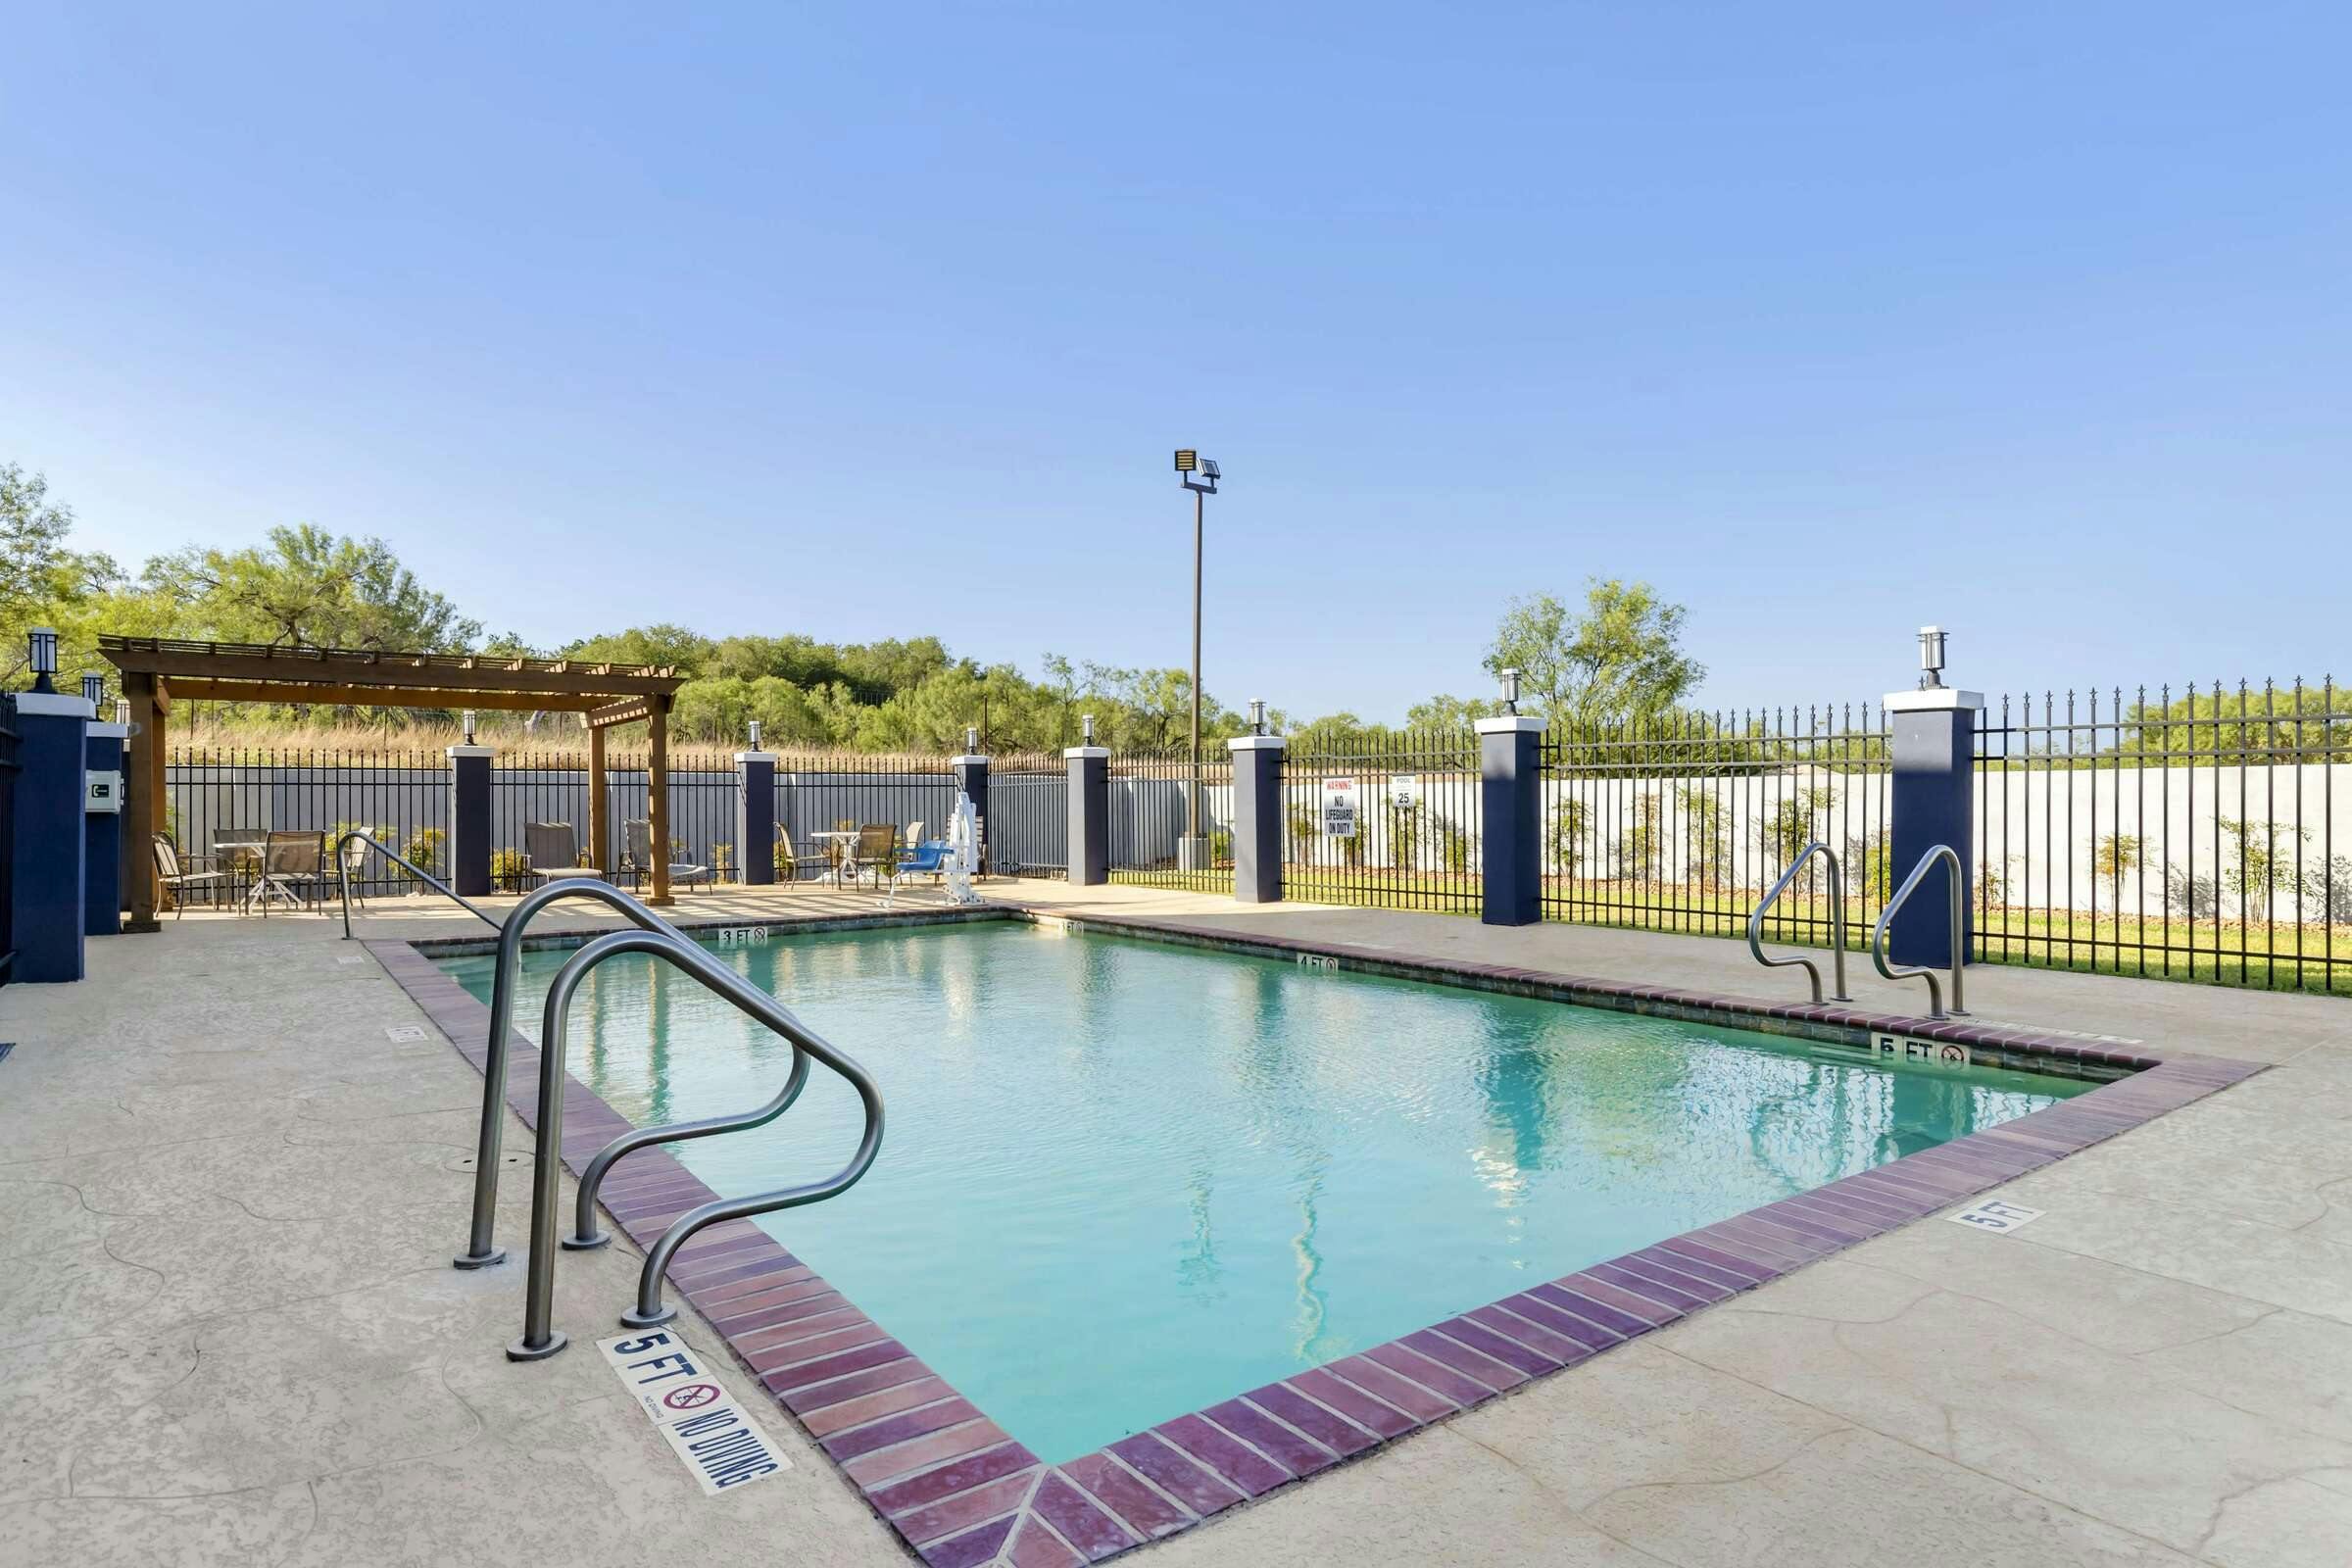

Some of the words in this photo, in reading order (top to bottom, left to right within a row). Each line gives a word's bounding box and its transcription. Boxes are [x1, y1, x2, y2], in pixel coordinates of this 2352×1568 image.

[1326, 780, 1352, 790] WARNING
[1334, 795, 1344, 807] NO
[1397, 792, 1409, 804] 25
[1325, 808, 1353, 820] LIFEGUARD
[1328, 822, 1336, 834] ON
[1337, 822, 1350, 834] DUTY
[736, 929, 751, 944] FT
[1906, 1040, 1934, 1058] FT
[1978, 1200, 2034, 1220] FT
[1960, 1213, 2008, 1228] 5
[613, 1333, 670, 1354] 5
[627, 1352, 699, 1385] FT
[671, 1407, 740, 1438] NO
[688, 1427, 779, 1489] DIVING
